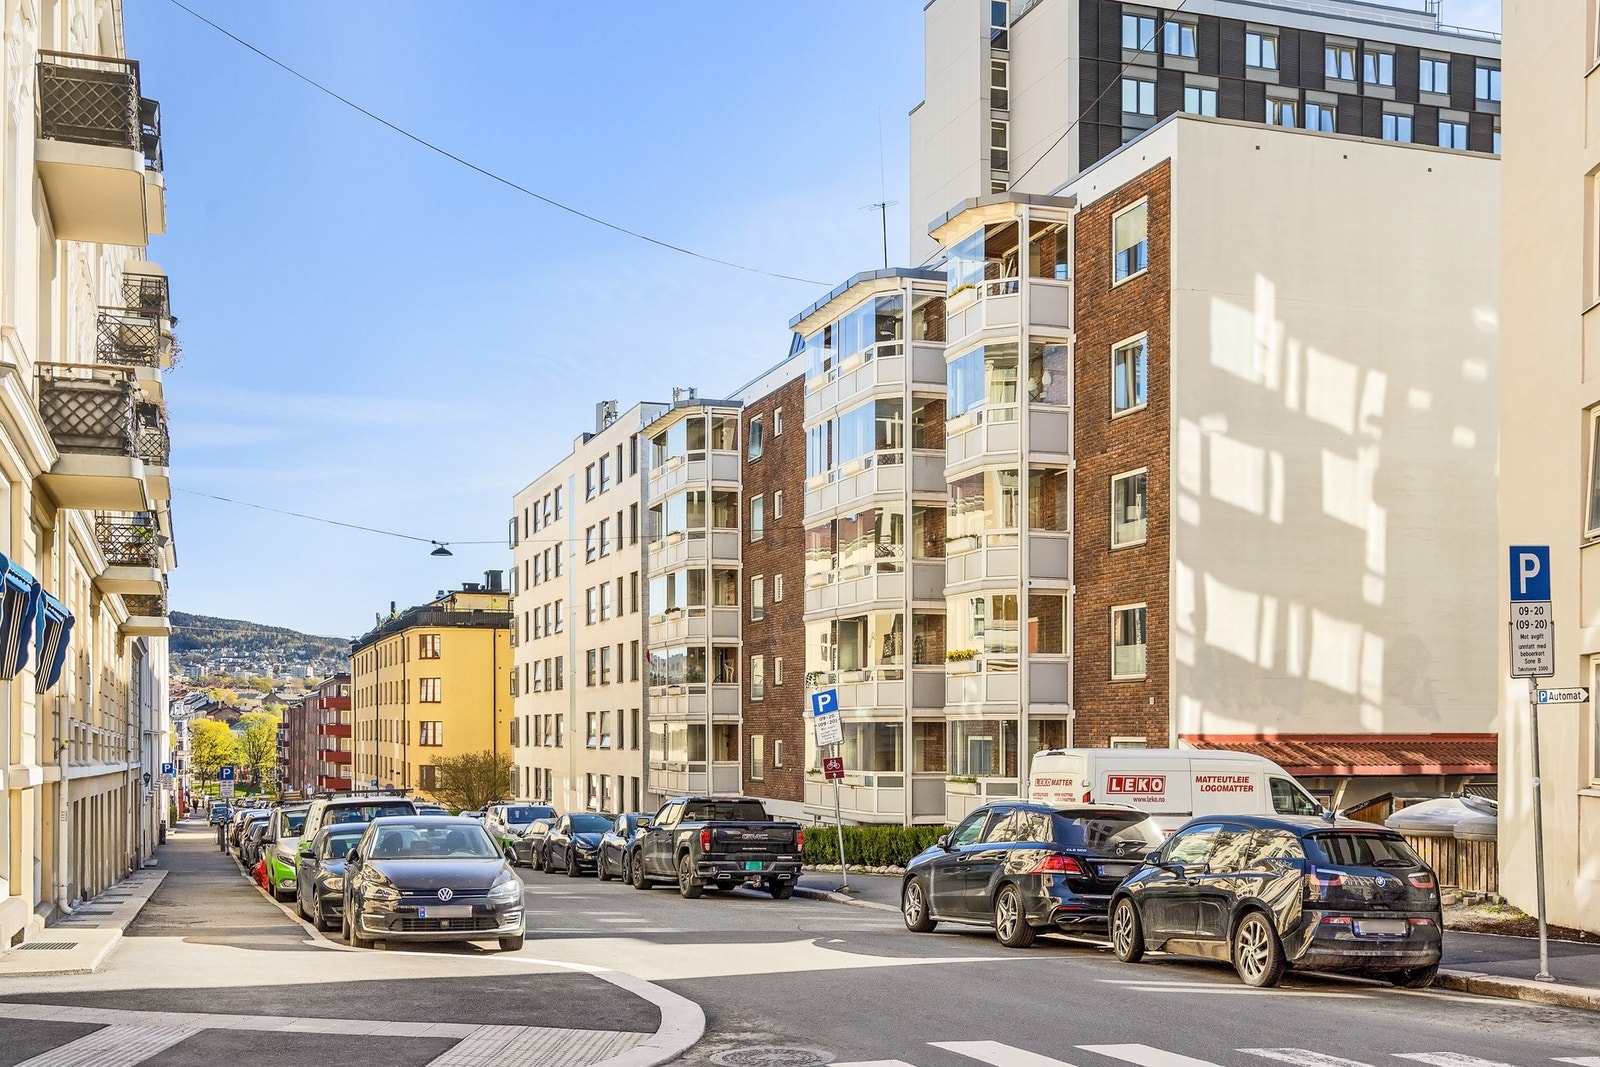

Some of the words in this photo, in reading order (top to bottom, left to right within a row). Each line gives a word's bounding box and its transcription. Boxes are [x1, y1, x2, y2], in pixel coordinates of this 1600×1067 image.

[1519, 552, 1541, 594] P
[1530, 633, 1545, 641] avgift
[1524, 657, 1536, 665] Sone
[1549, 691, 1582, 701] Automat
[817, 693, 832, 713] P
[164, 764, 171, 773] P
[222, 768, 231, 779] P
[1051, 779, 1073, 787] MATTER
[1109, 776, 1164, 792] LEKO
[1194, 775, 1250, 784] MATTEUTLEIE
[1200, 784, 1254, 793] LOGOMATTER
